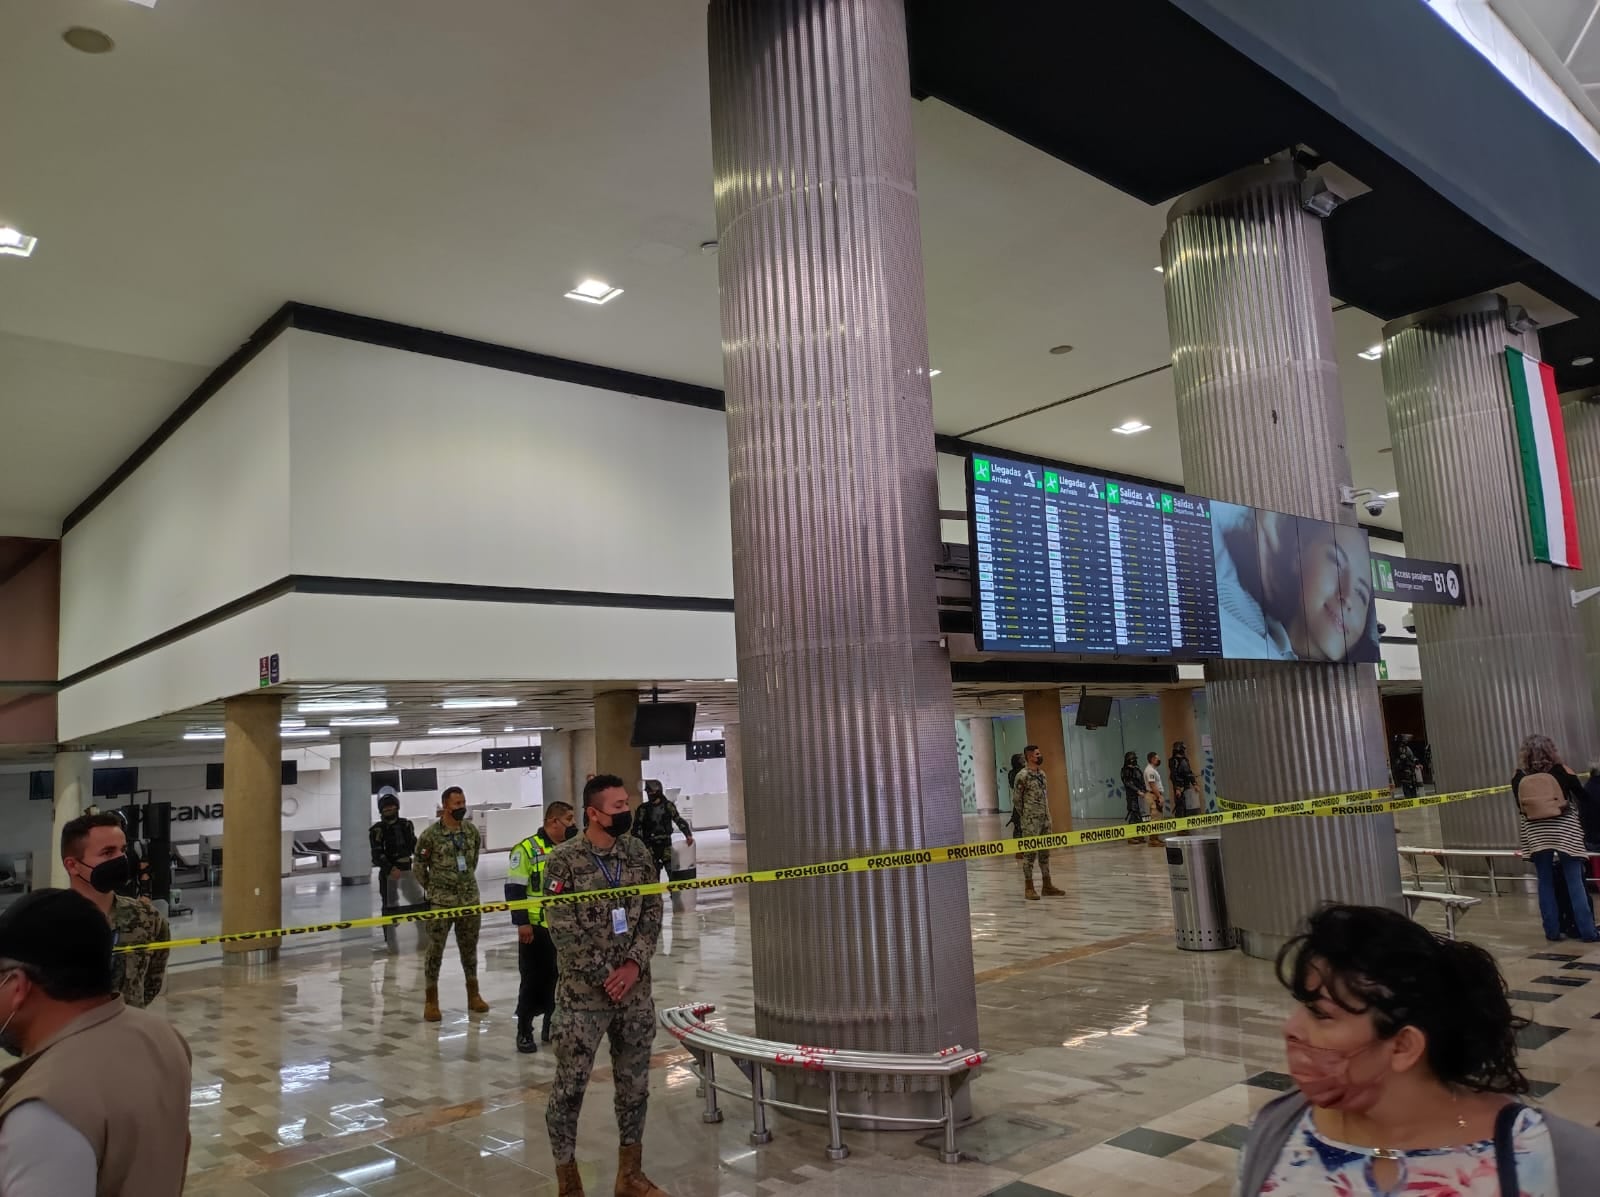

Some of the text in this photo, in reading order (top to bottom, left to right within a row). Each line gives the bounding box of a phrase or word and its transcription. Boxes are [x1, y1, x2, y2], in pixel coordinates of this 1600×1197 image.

[991, 464, 1021, 477] Llegadas
[991, 476, 1012, 485] Arrivals
[1059, 476, 1086, 489] Llegadas
[1120, 488, 1143, 500] Salidas
[1173, 498, 1194, 510] Salidas
[1433, 573, 1446, 592] B1
[1331, 803, 1383, 815] PROHIBIDO
[1390, 799, 1414, 809] PROHIBIDO
[775, 862, 849, 880] PROHIBIDO
[867, 851, 932, 869] PROHIBIDO
[947, 843, 1004, 860] PROHIBIDO
[1018, 835, 1068, 851] PROHIBIDO
[1080, 827, 1125, 842] PROHIBIDO
[1136, 820, 1177, 834] PROHIBIDO
[1187, 814, 1224, 828] PROHIBIDO
[1232, 808, 1266, 820] PROHIBIDO
[1273, 802, 1304, 814] PROHIBIDO
[1312, 796, 1339, 808] PROHIBIDO
[1346, 791, 1372, 803] PROHIBIDO
